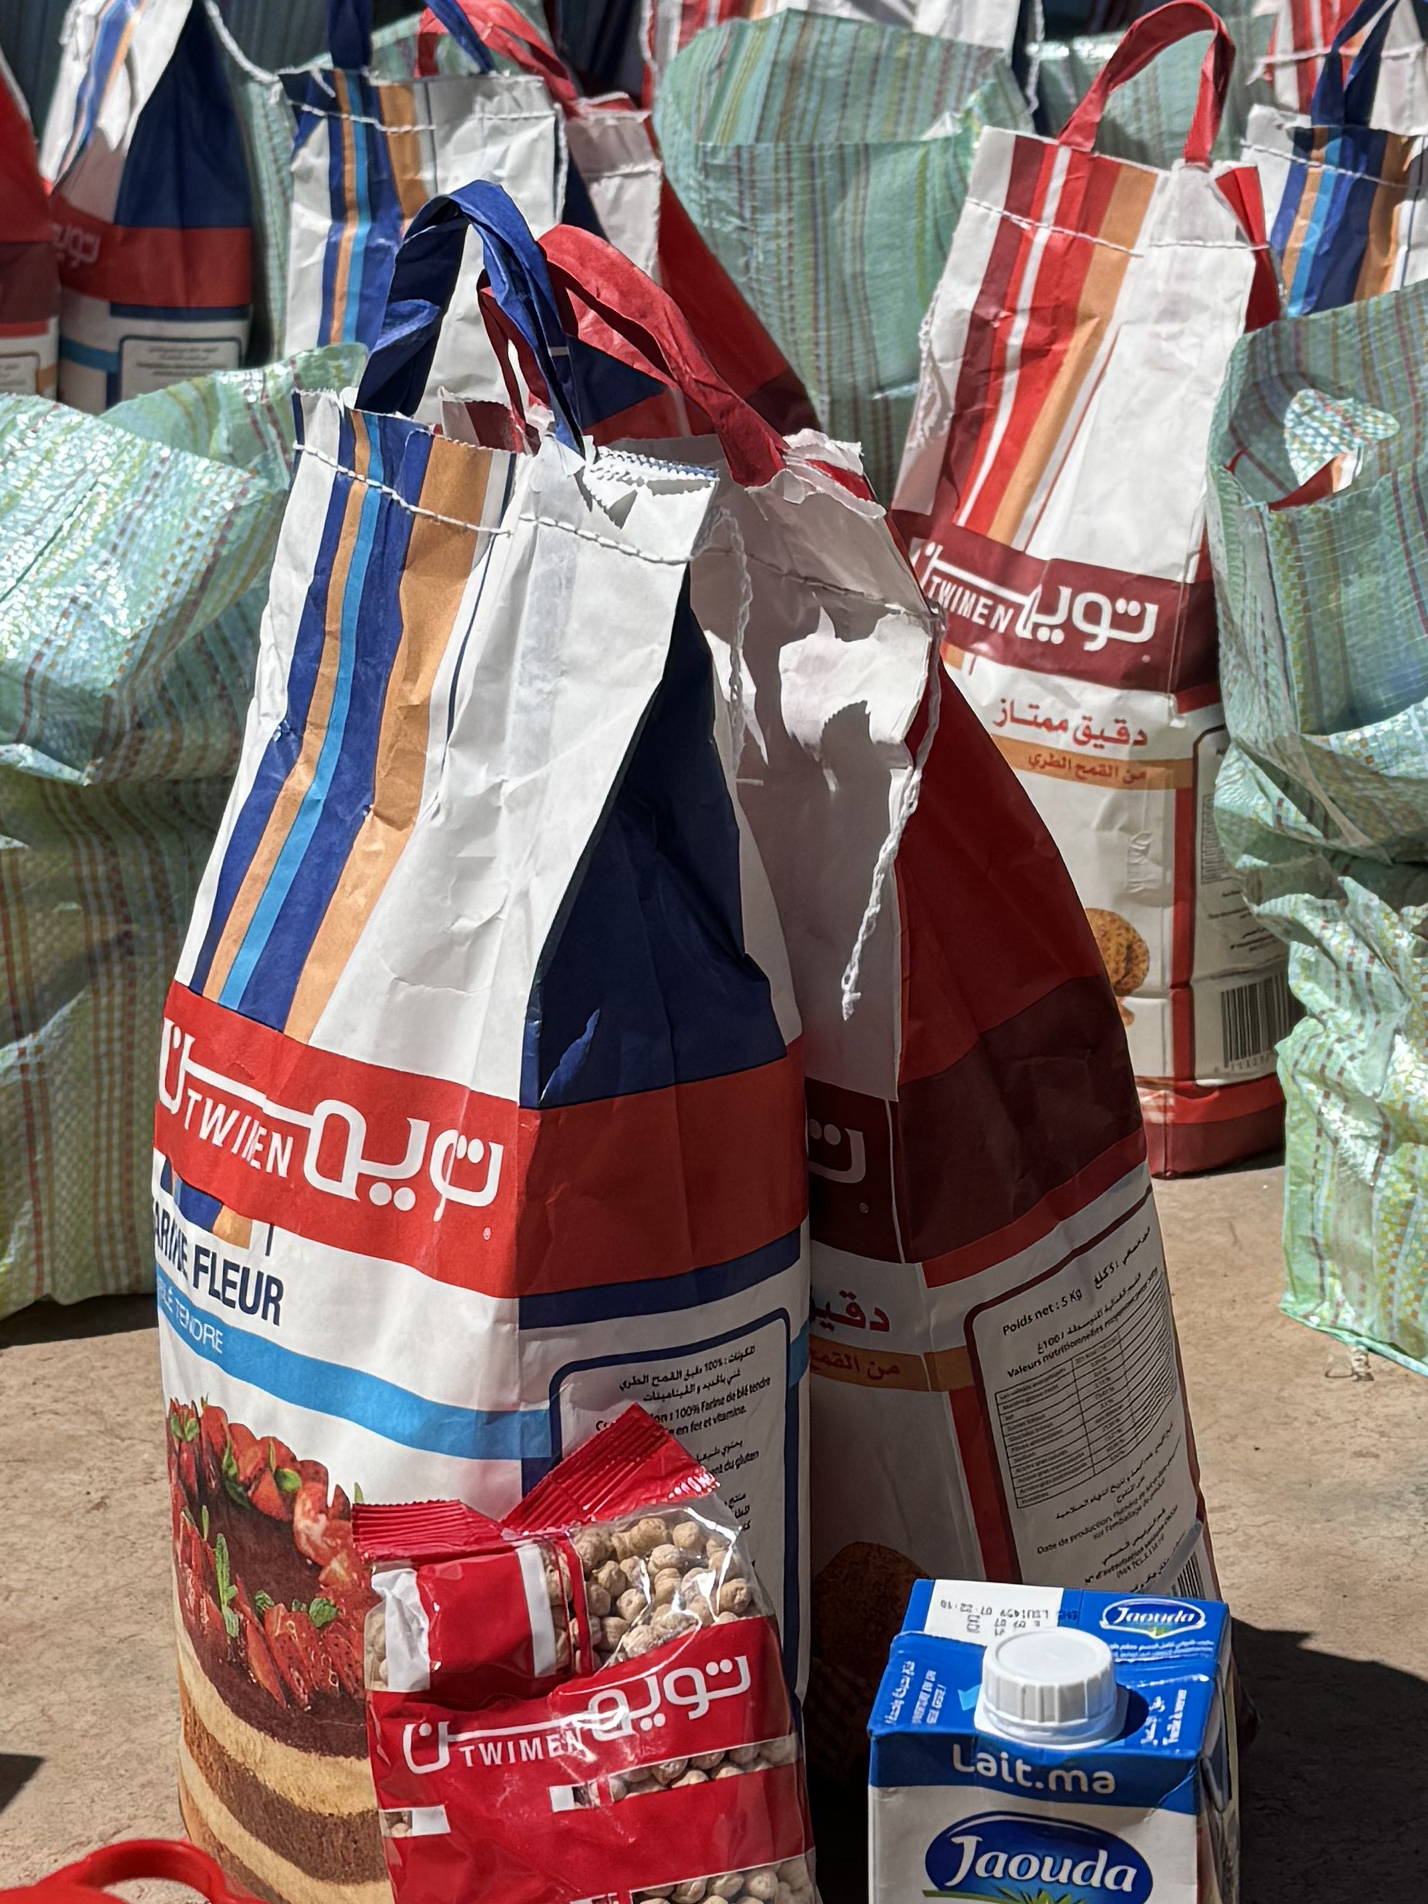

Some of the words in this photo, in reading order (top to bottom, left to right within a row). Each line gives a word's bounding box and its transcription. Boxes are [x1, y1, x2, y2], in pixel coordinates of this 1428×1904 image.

[928, 575, 1013, 636] TWIMEN
[993, 696, 1068, 735] ممتاز
[1071, 714, 1148, 749] دقيق
[1028, 750, 1071, 780] الطري
[1073, 760, 1118, 782] القمح
[1120, 764, 1147, 784] من
[153, 1200, 188, 1280] ARINE
[193, 1244, 284, 1326] FLEUR
[175, 1298, 224, 1354] TENDRE
[810, 1289, 891, 1332] دقي
[1000, 1312, 1034, 1337] Poids
[1034, 1303, 1055, 1320] net
[1058, 1295, 1069, 1307] 5
[1066, 1287, 1084, 1304] Kg
[810, 1347, 861, 1373] القم
[867, 1362, 901, 1381] من
[1006, 1355, 1042, 1380] Valeurs
[619, 1375, 649, 1391] الطري
[701, 1396, 725, 1413] Farine
[727, 1391, 736, 1403] de
[749, 1375, 771, 1392] tendre
[735, 1450, 760, 1469] gluten
[1116, 1607, 1196, 1624] Jaouda
[459, 1731, 585, 1770] TWIMEN
[954, 1744, 1116, 1795] Lait.ma
[945, 1834, 1138, 1893] Jaouda
